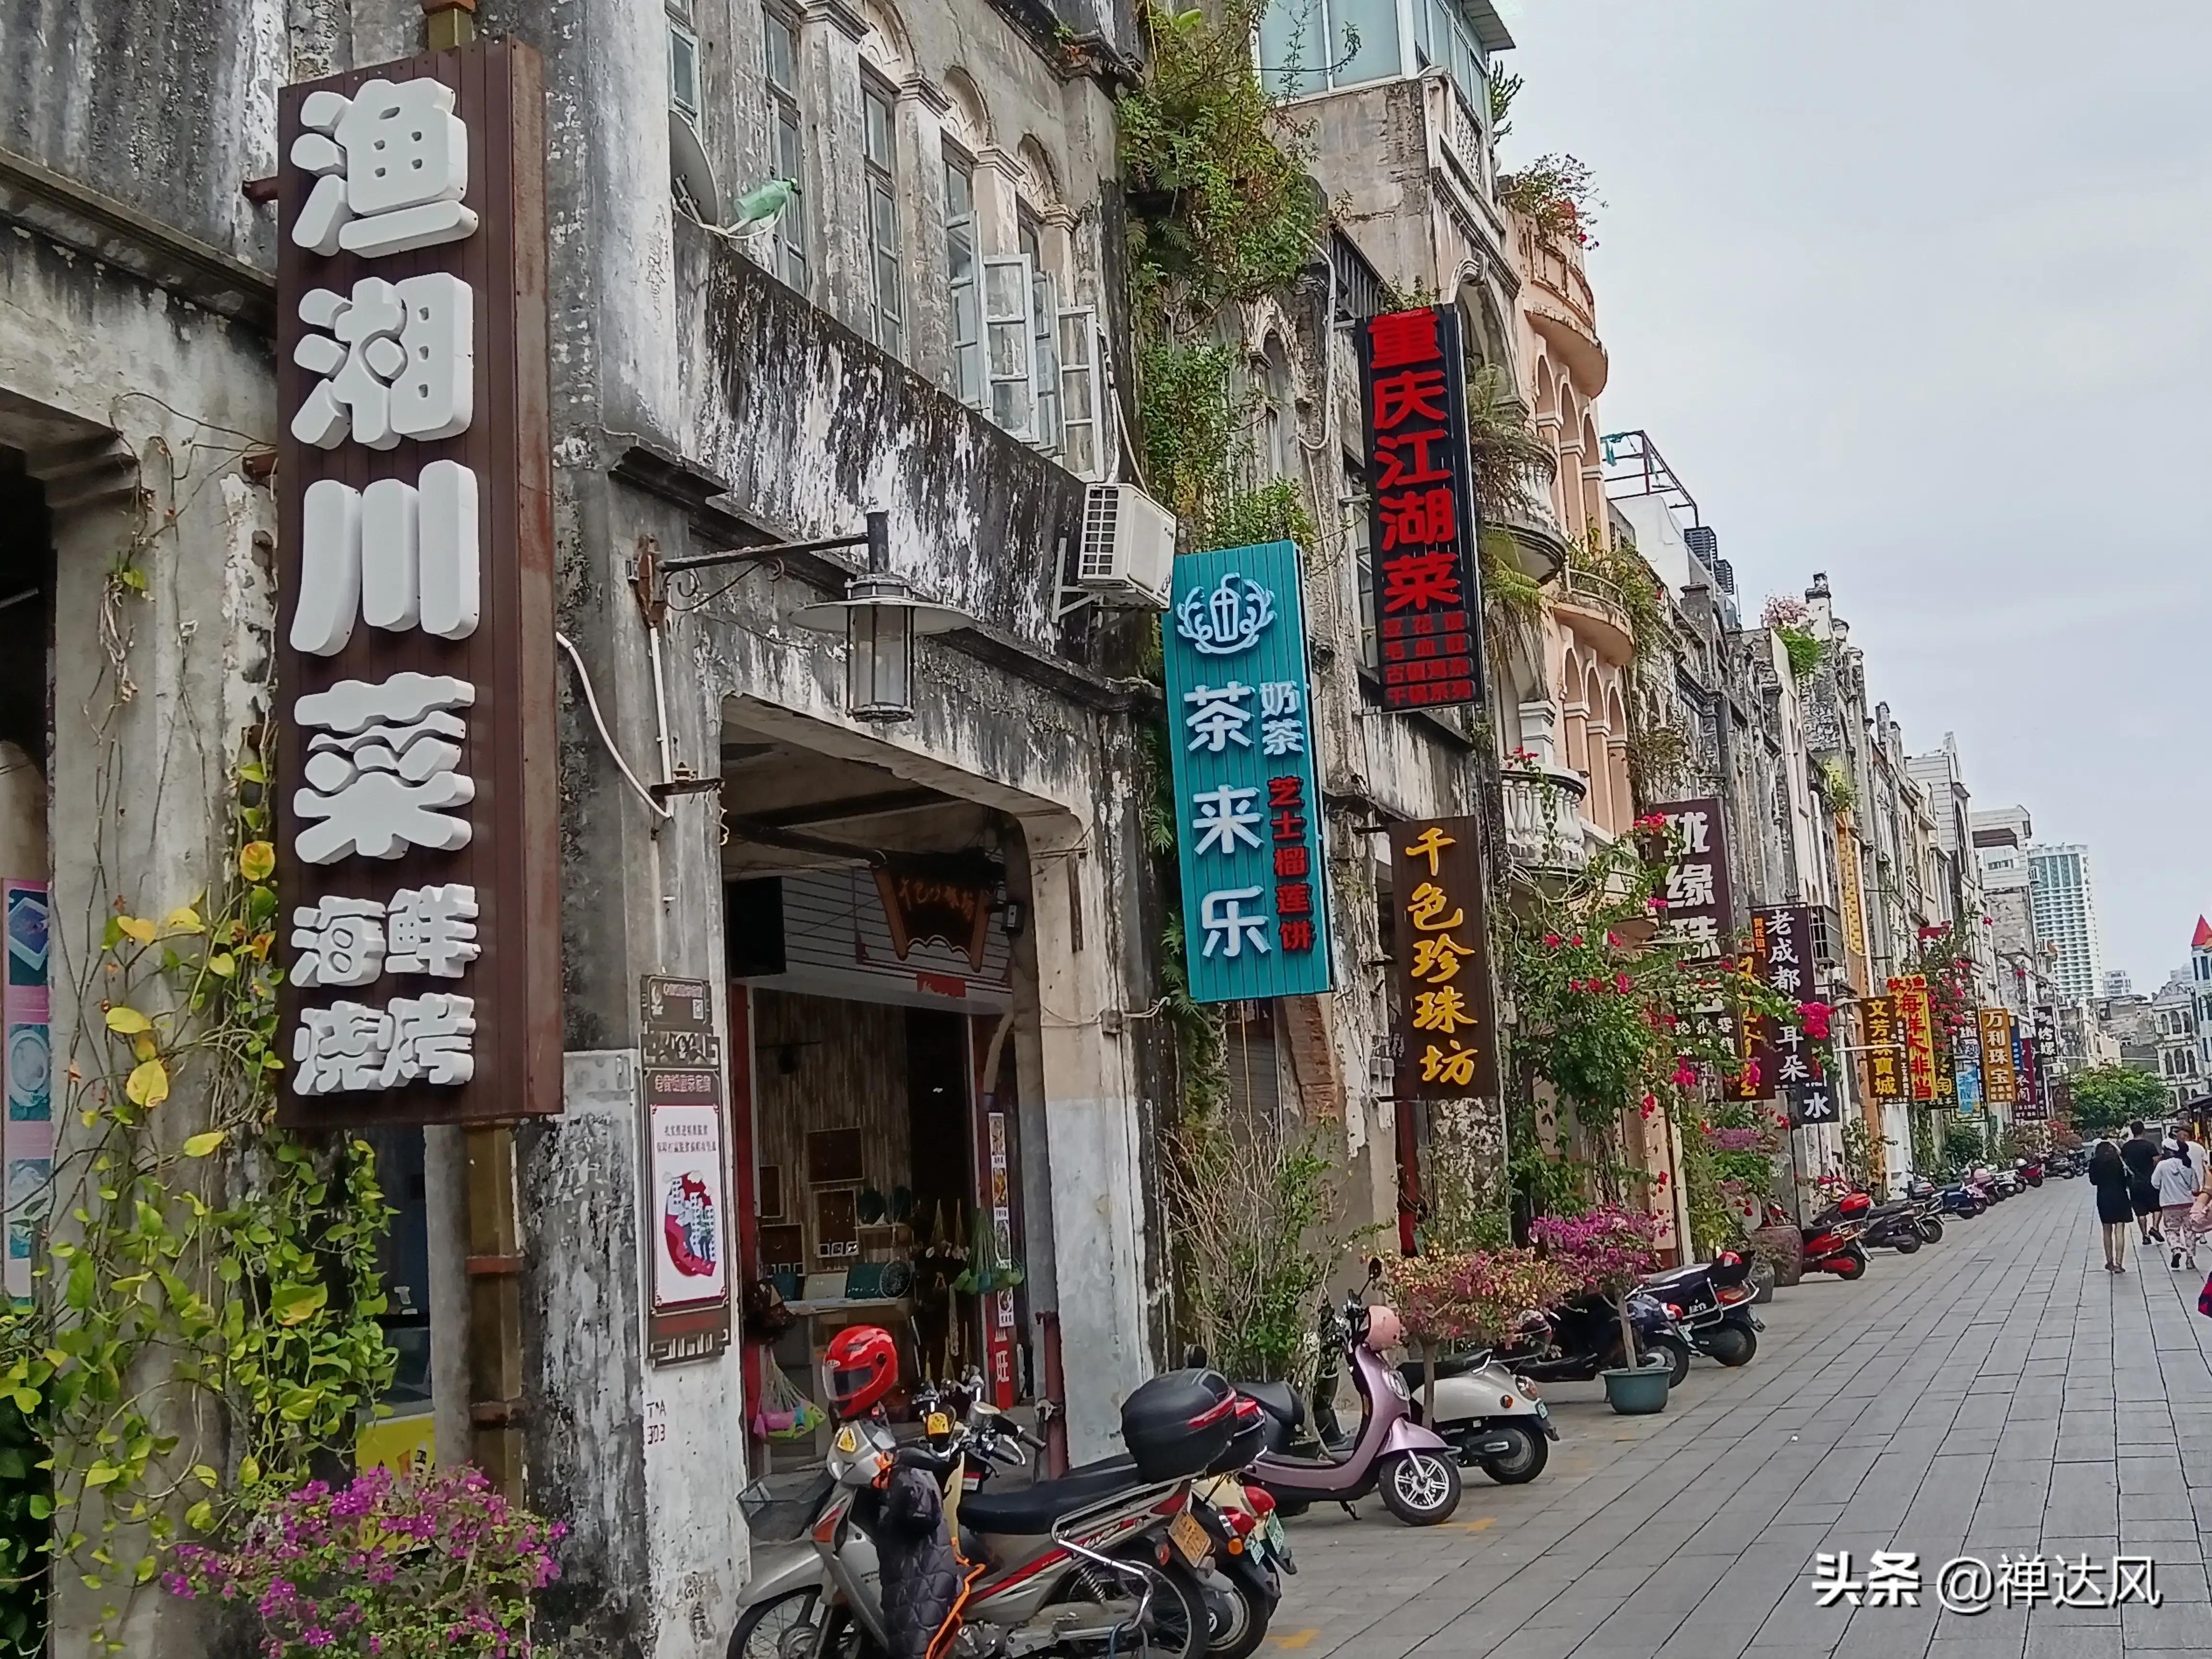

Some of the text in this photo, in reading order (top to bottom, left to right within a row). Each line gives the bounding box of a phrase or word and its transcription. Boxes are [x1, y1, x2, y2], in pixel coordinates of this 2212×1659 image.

[1368, 307, 1461, 613] 重庆江湖菜
[1259, 681, 1305, 756] 奶茶
[1184, 680, 1269, 958] 茶来乐
[1268, 776, 1313, 952] 芝士榴莲饼
[289, 884, 481, 987] 海鲜
[1406, 827, 1479, 1085] 千色珍珠坊
[293, 992, 476, 1095] 烧烤
[1984, 1011, 2009, 1084] 万利珠宝
